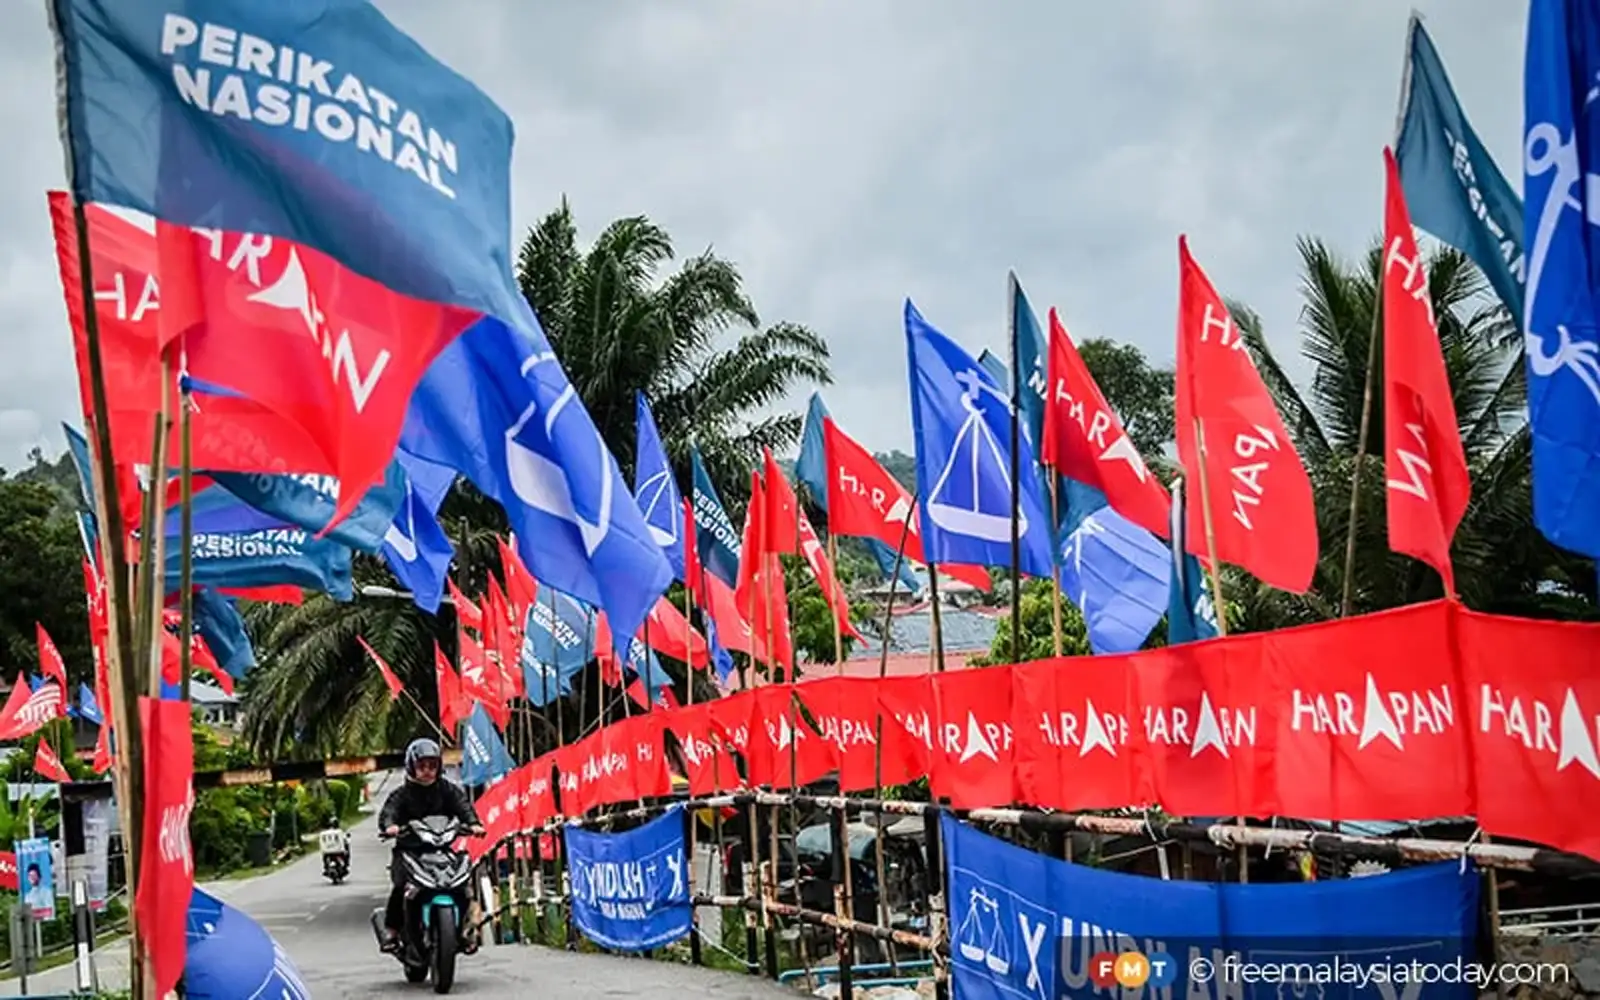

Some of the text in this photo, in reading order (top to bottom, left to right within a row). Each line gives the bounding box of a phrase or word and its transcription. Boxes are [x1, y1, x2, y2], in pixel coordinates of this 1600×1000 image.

[160, 13, 459, 175] PERIKATAN
[171, 64, 457, 199] NASIONAL
[1291, 671, 1453, 751] HARAPAN
[1481, 684, 1600, 780] HARA
